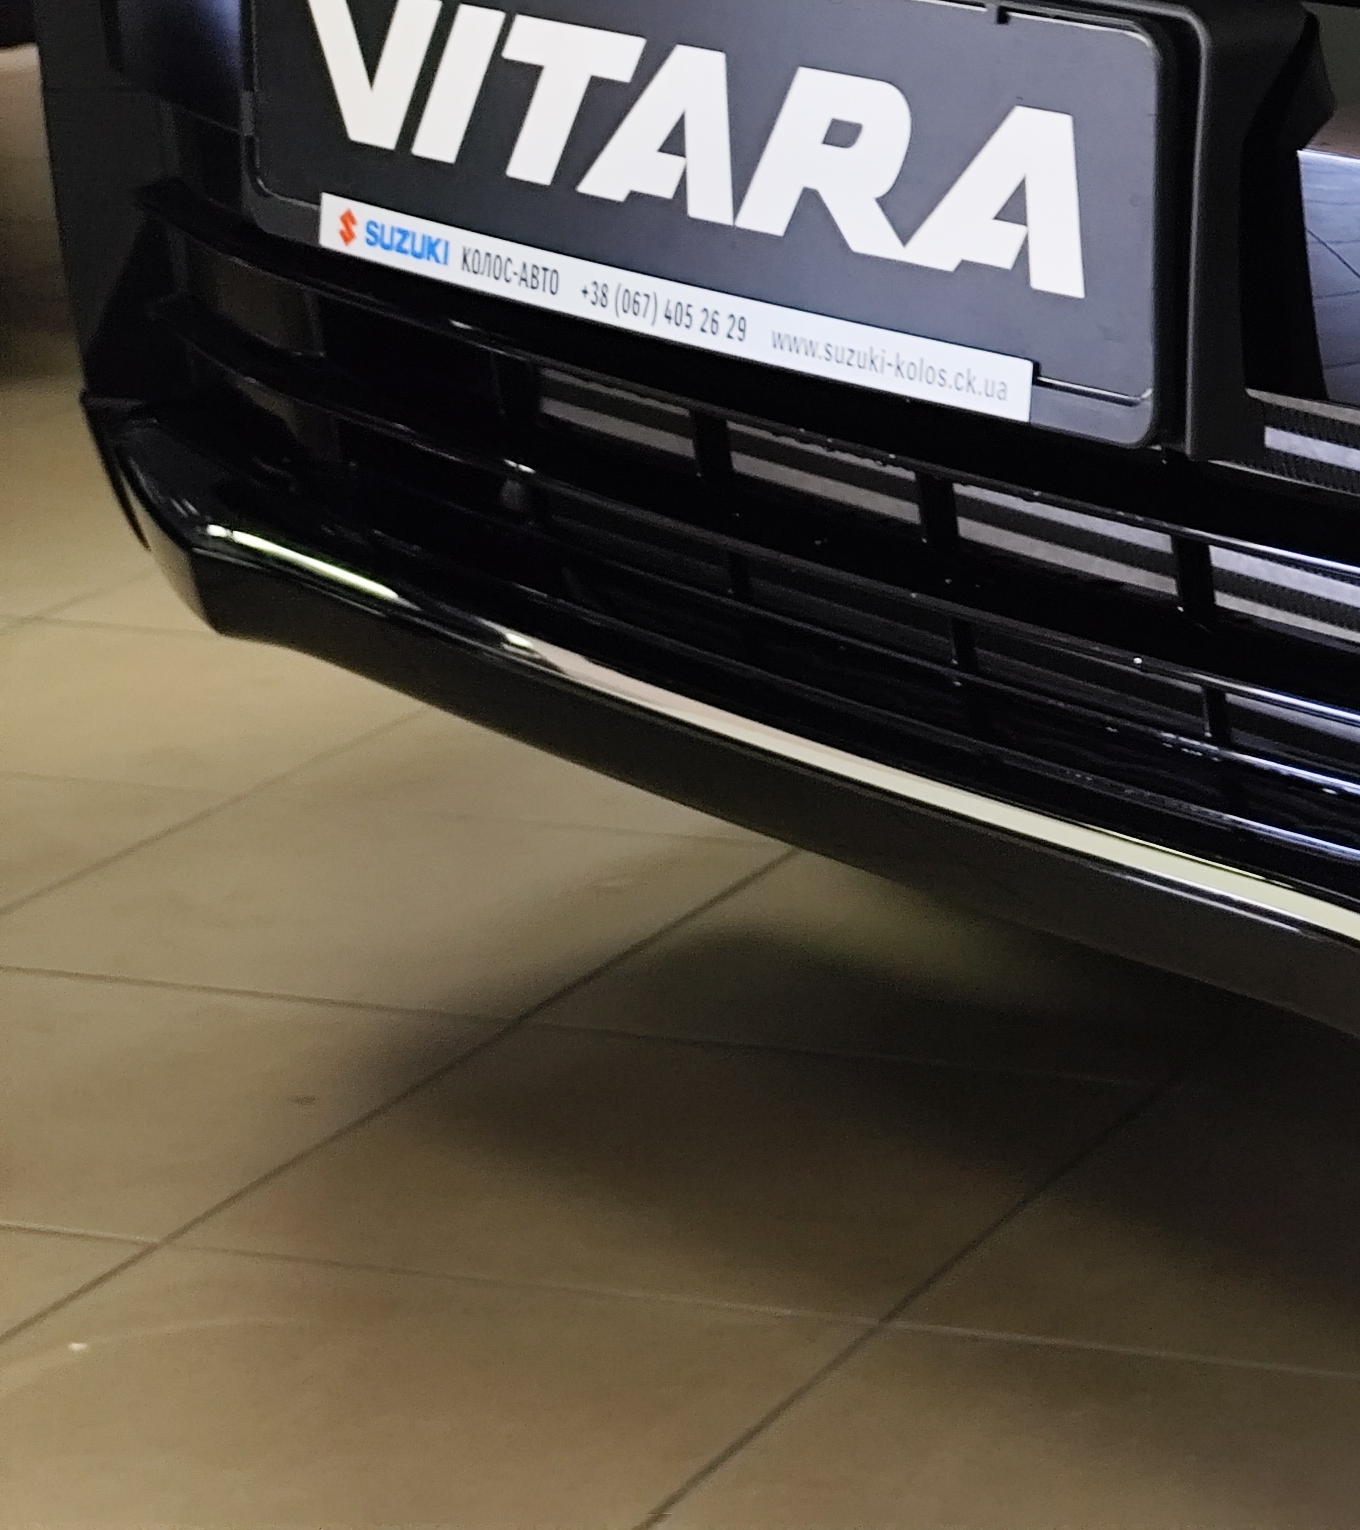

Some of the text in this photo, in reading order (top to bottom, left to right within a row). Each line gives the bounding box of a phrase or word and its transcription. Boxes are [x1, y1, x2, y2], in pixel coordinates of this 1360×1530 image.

[365, 220, 1008, 401] SUZUKI КОЛОС-АВТО +38 (067) 405 26 29 www.suzuki-kolos.ck.ua
